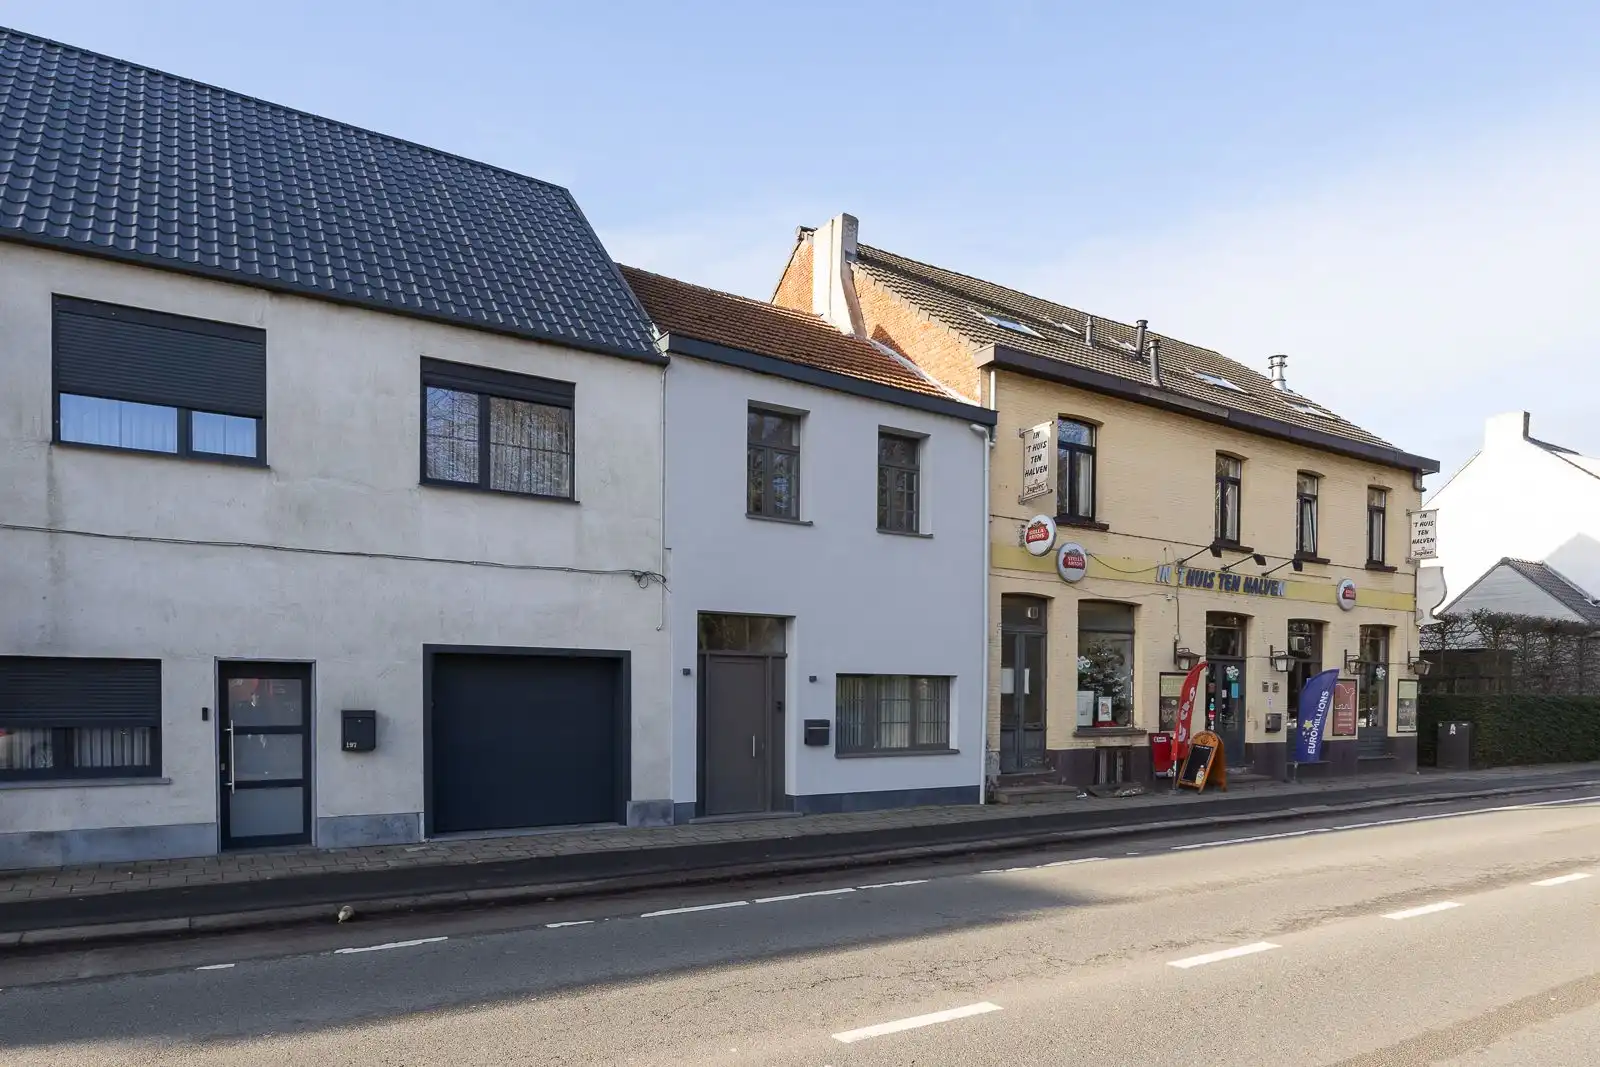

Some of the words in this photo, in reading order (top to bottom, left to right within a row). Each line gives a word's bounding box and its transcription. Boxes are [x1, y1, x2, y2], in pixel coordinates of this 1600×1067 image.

[1032, 430, 1040, 439] IN
[1032, 440, 1047, 452] HUIS
[1030, 453, 1042, 464] TEN
[1024, 465, 1048, 478] HALVEN
[1156, 565, 1172, 584] IN
[1185, 568, 1216, 589] HUIS
[1217, 573, 1241, 592] TEN
[1243, 576, 1285, 597] HALVEN
[1307, 690, 1329, 754] EUROMILLIONS
